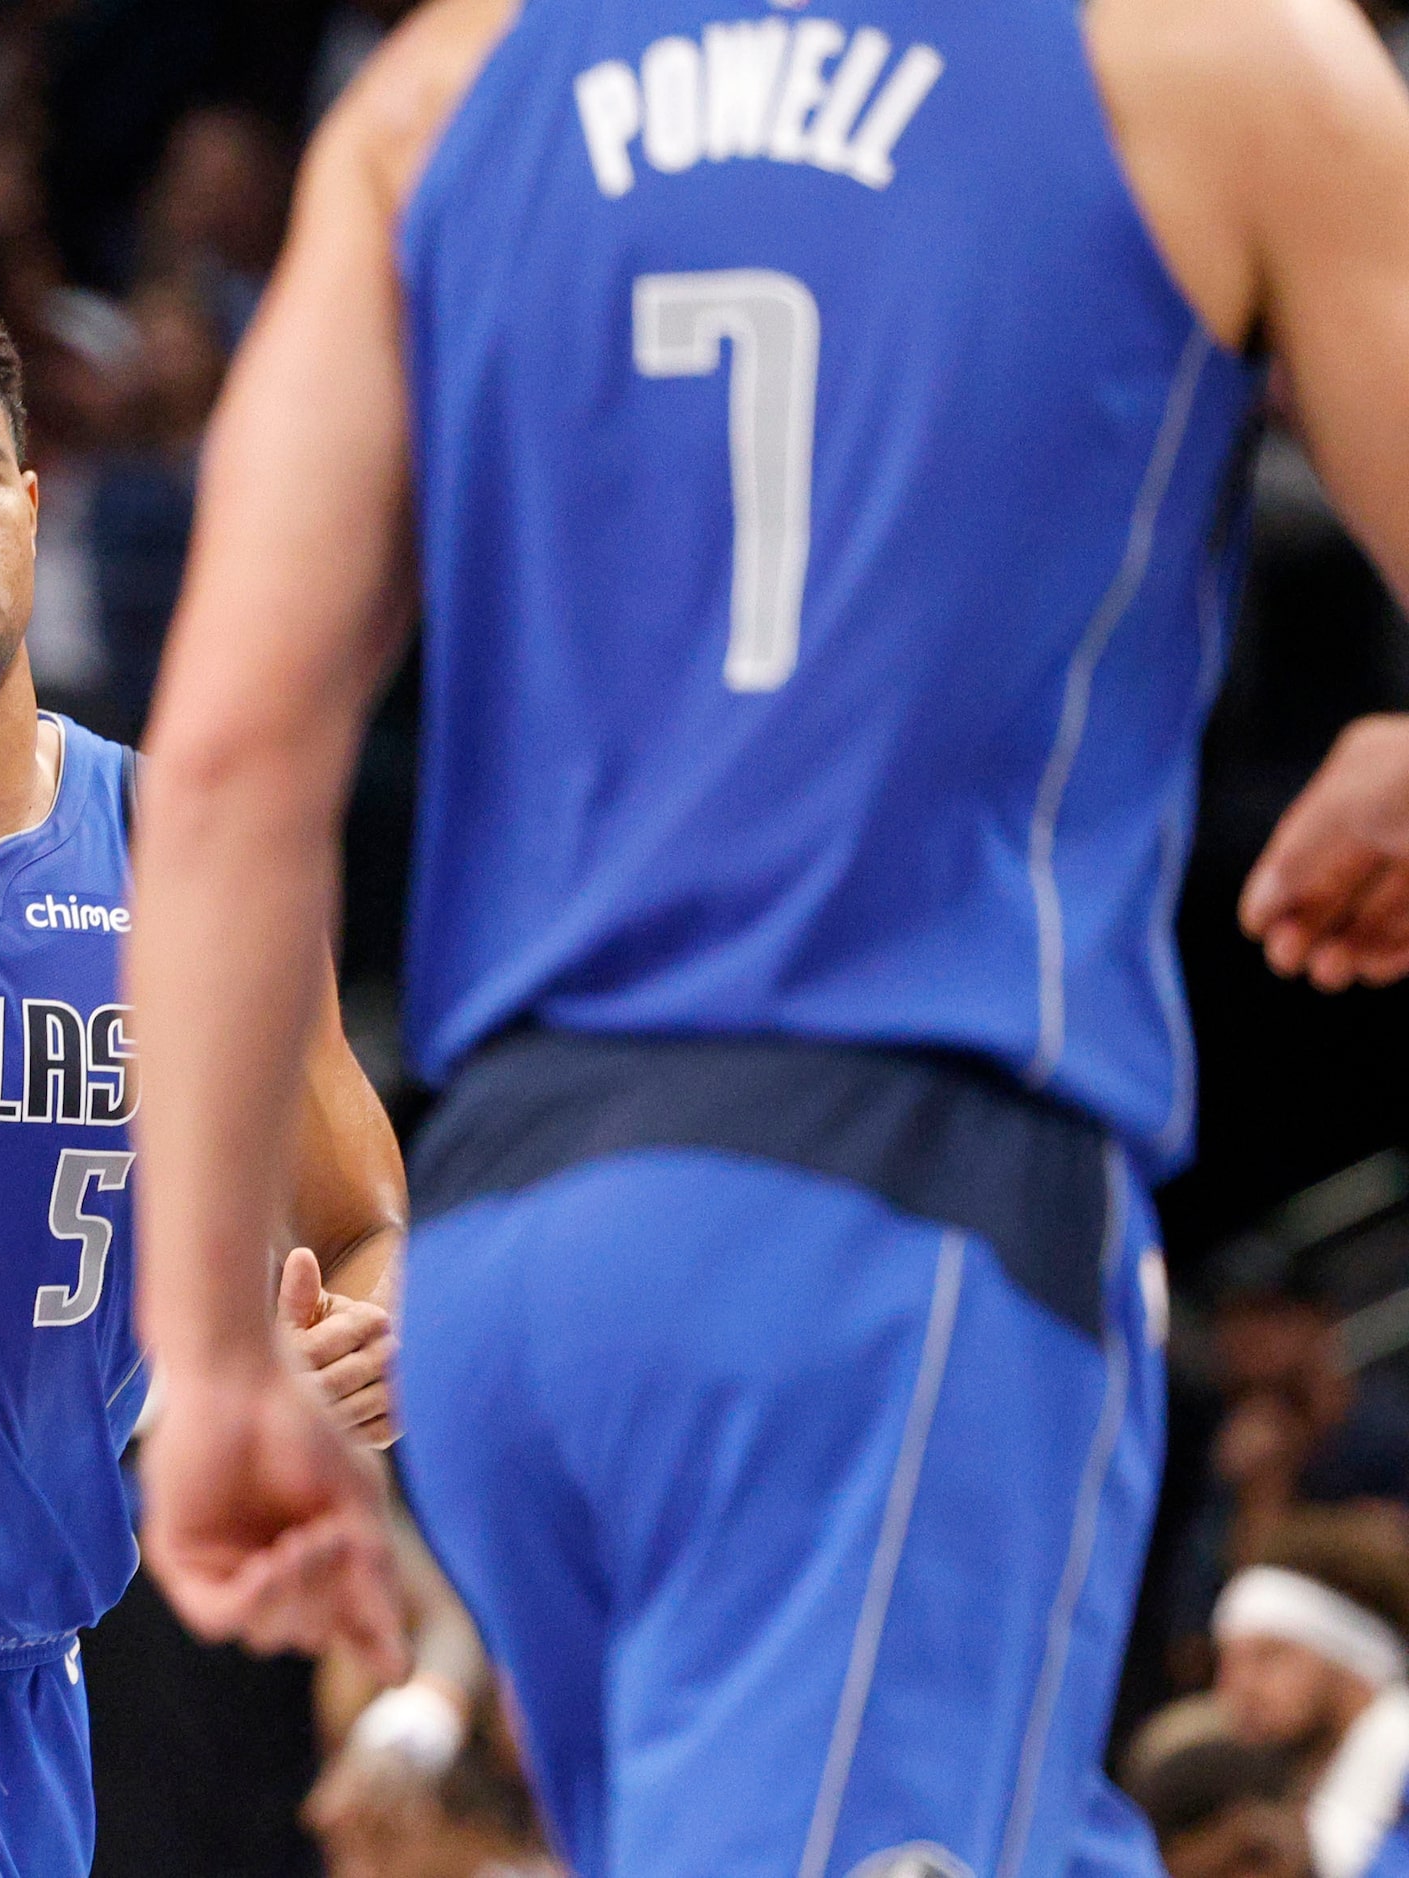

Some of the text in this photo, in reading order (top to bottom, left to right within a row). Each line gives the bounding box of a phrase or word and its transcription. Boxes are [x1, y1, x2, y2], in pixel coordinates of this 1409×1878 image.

[575, 18, 944, 197] POWELL
[633, 268, 820, 692] 7
[25, 894, 132, 932] chime
[33, 1148, 137, 1327] 5
